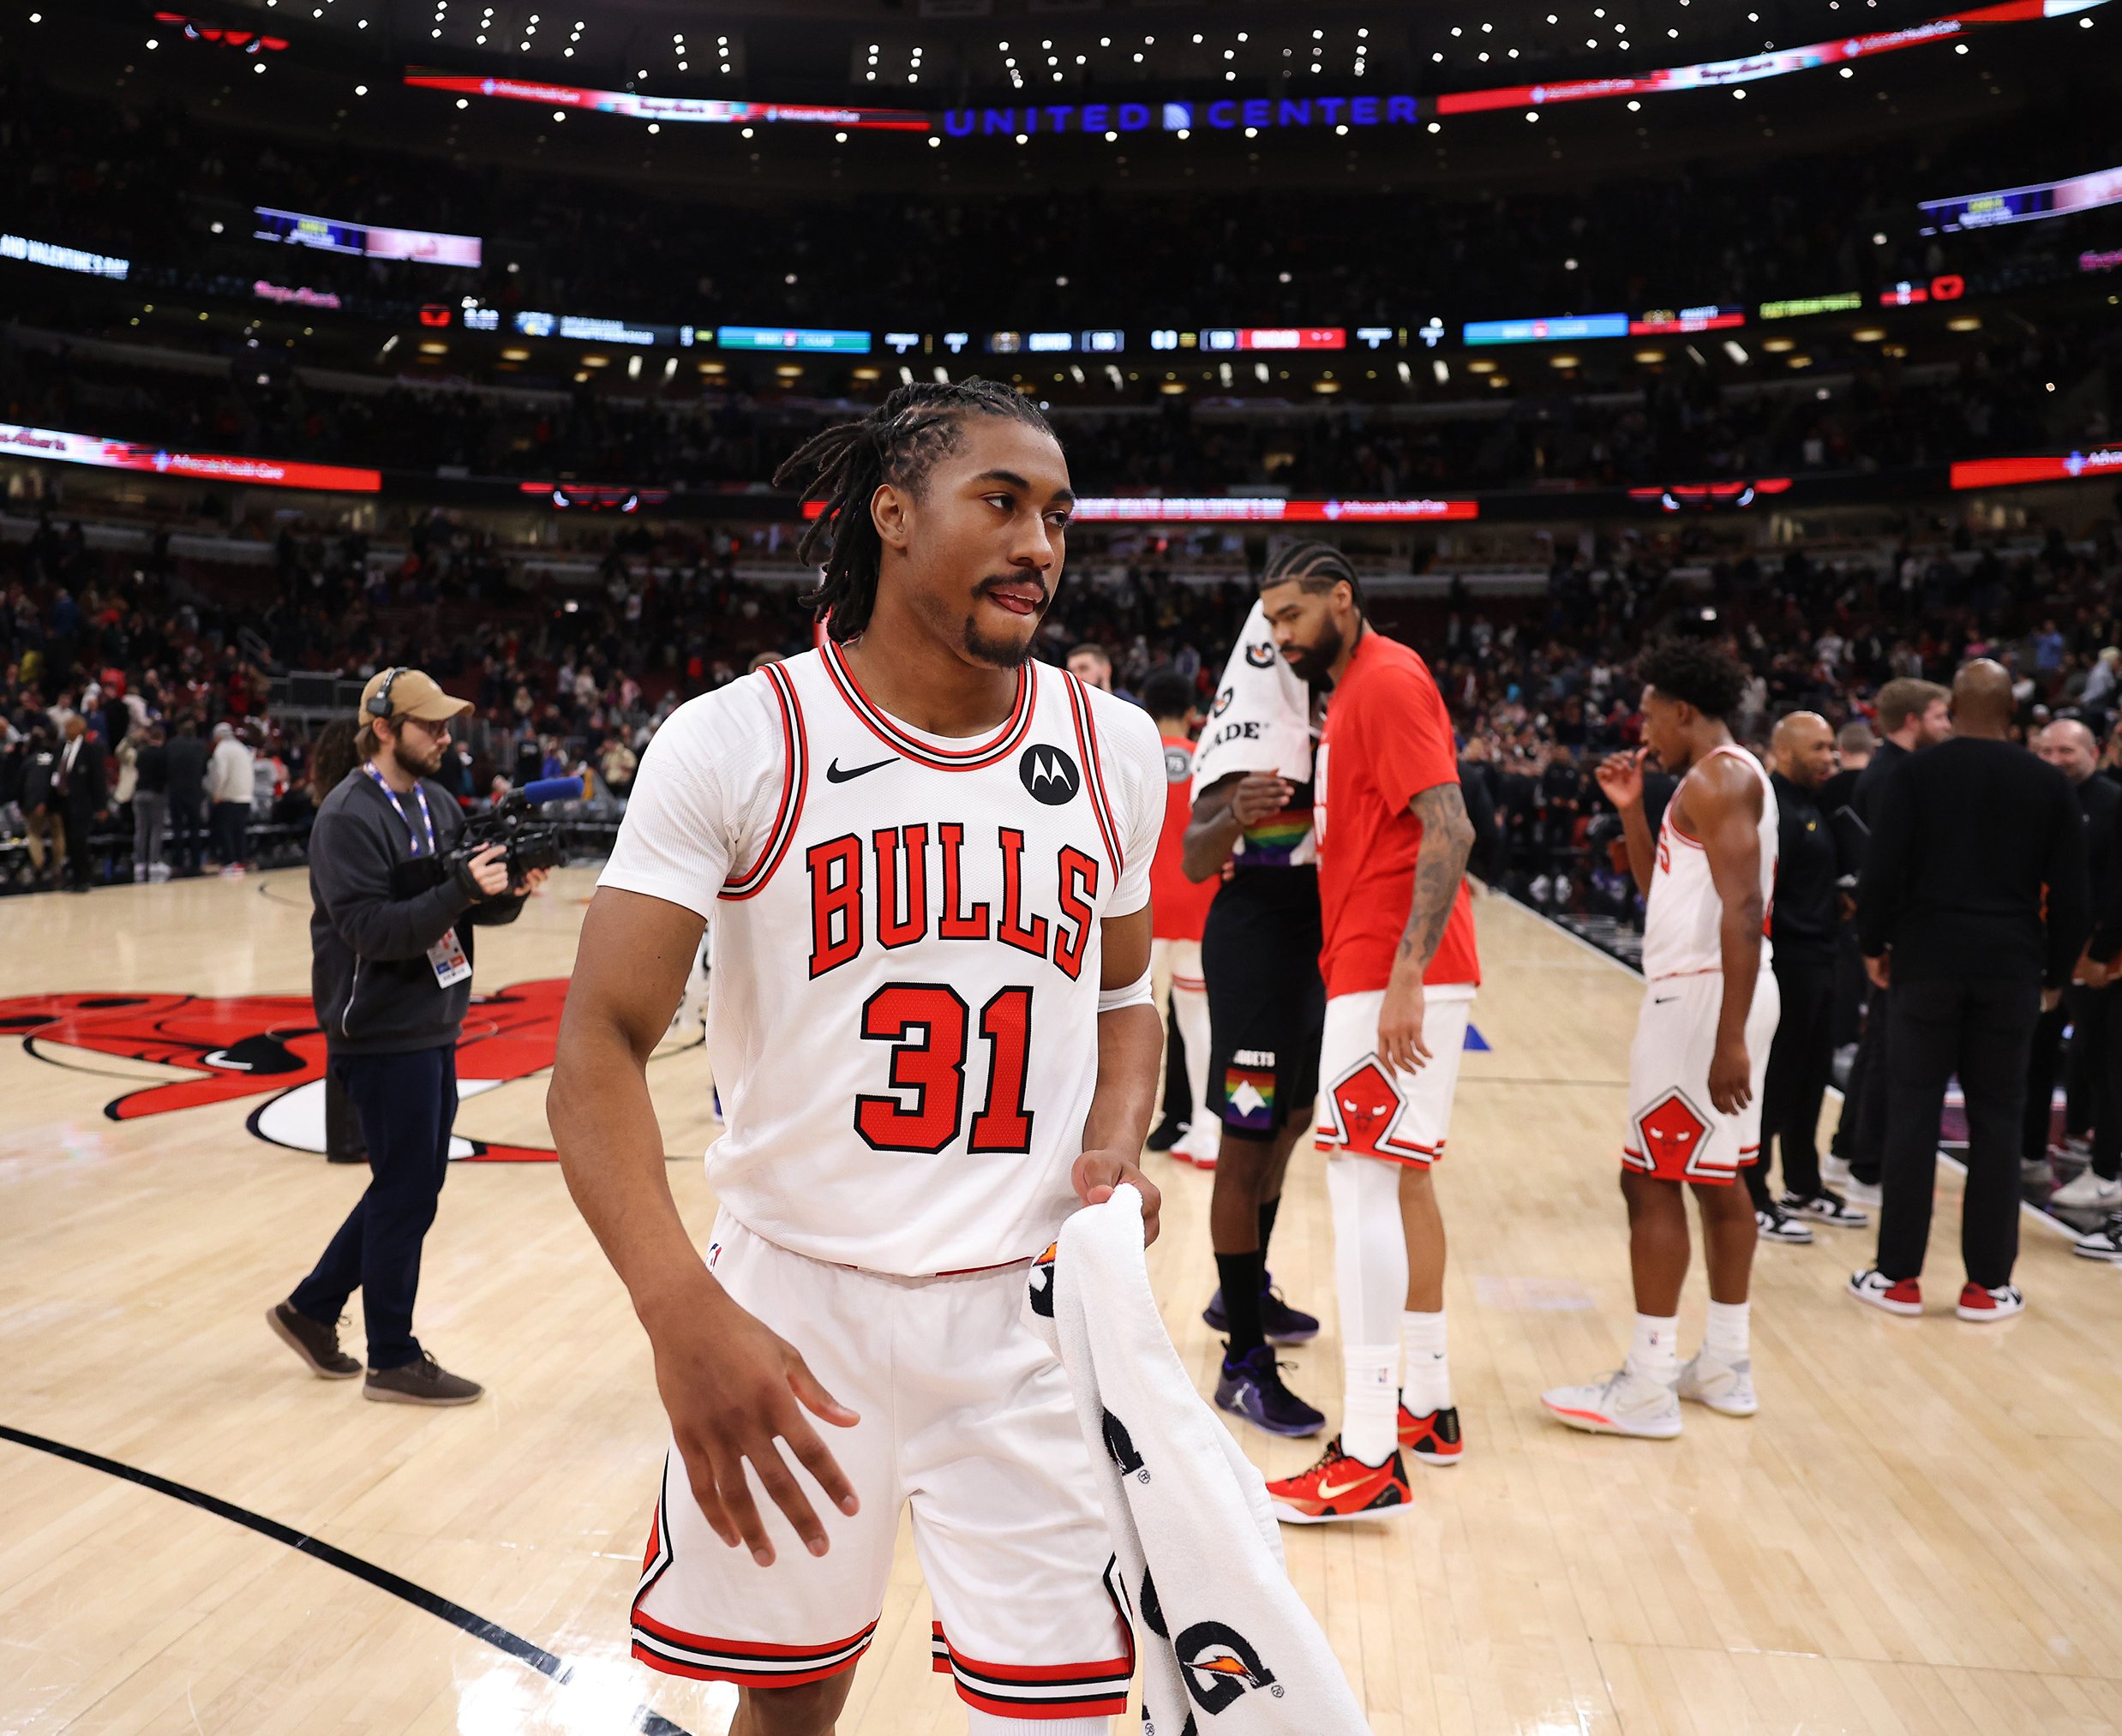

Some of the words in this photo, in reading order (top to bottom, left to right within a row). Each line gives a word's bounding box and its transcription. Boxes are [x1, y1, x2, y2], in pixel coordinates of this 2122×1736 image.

[944, 103, 1151, 137] UNITED
[1208, 95, 1418, 129] CENTER
[806, 823, 1099, 982] BULLS
[854, 982, 1034, 1155] 31
